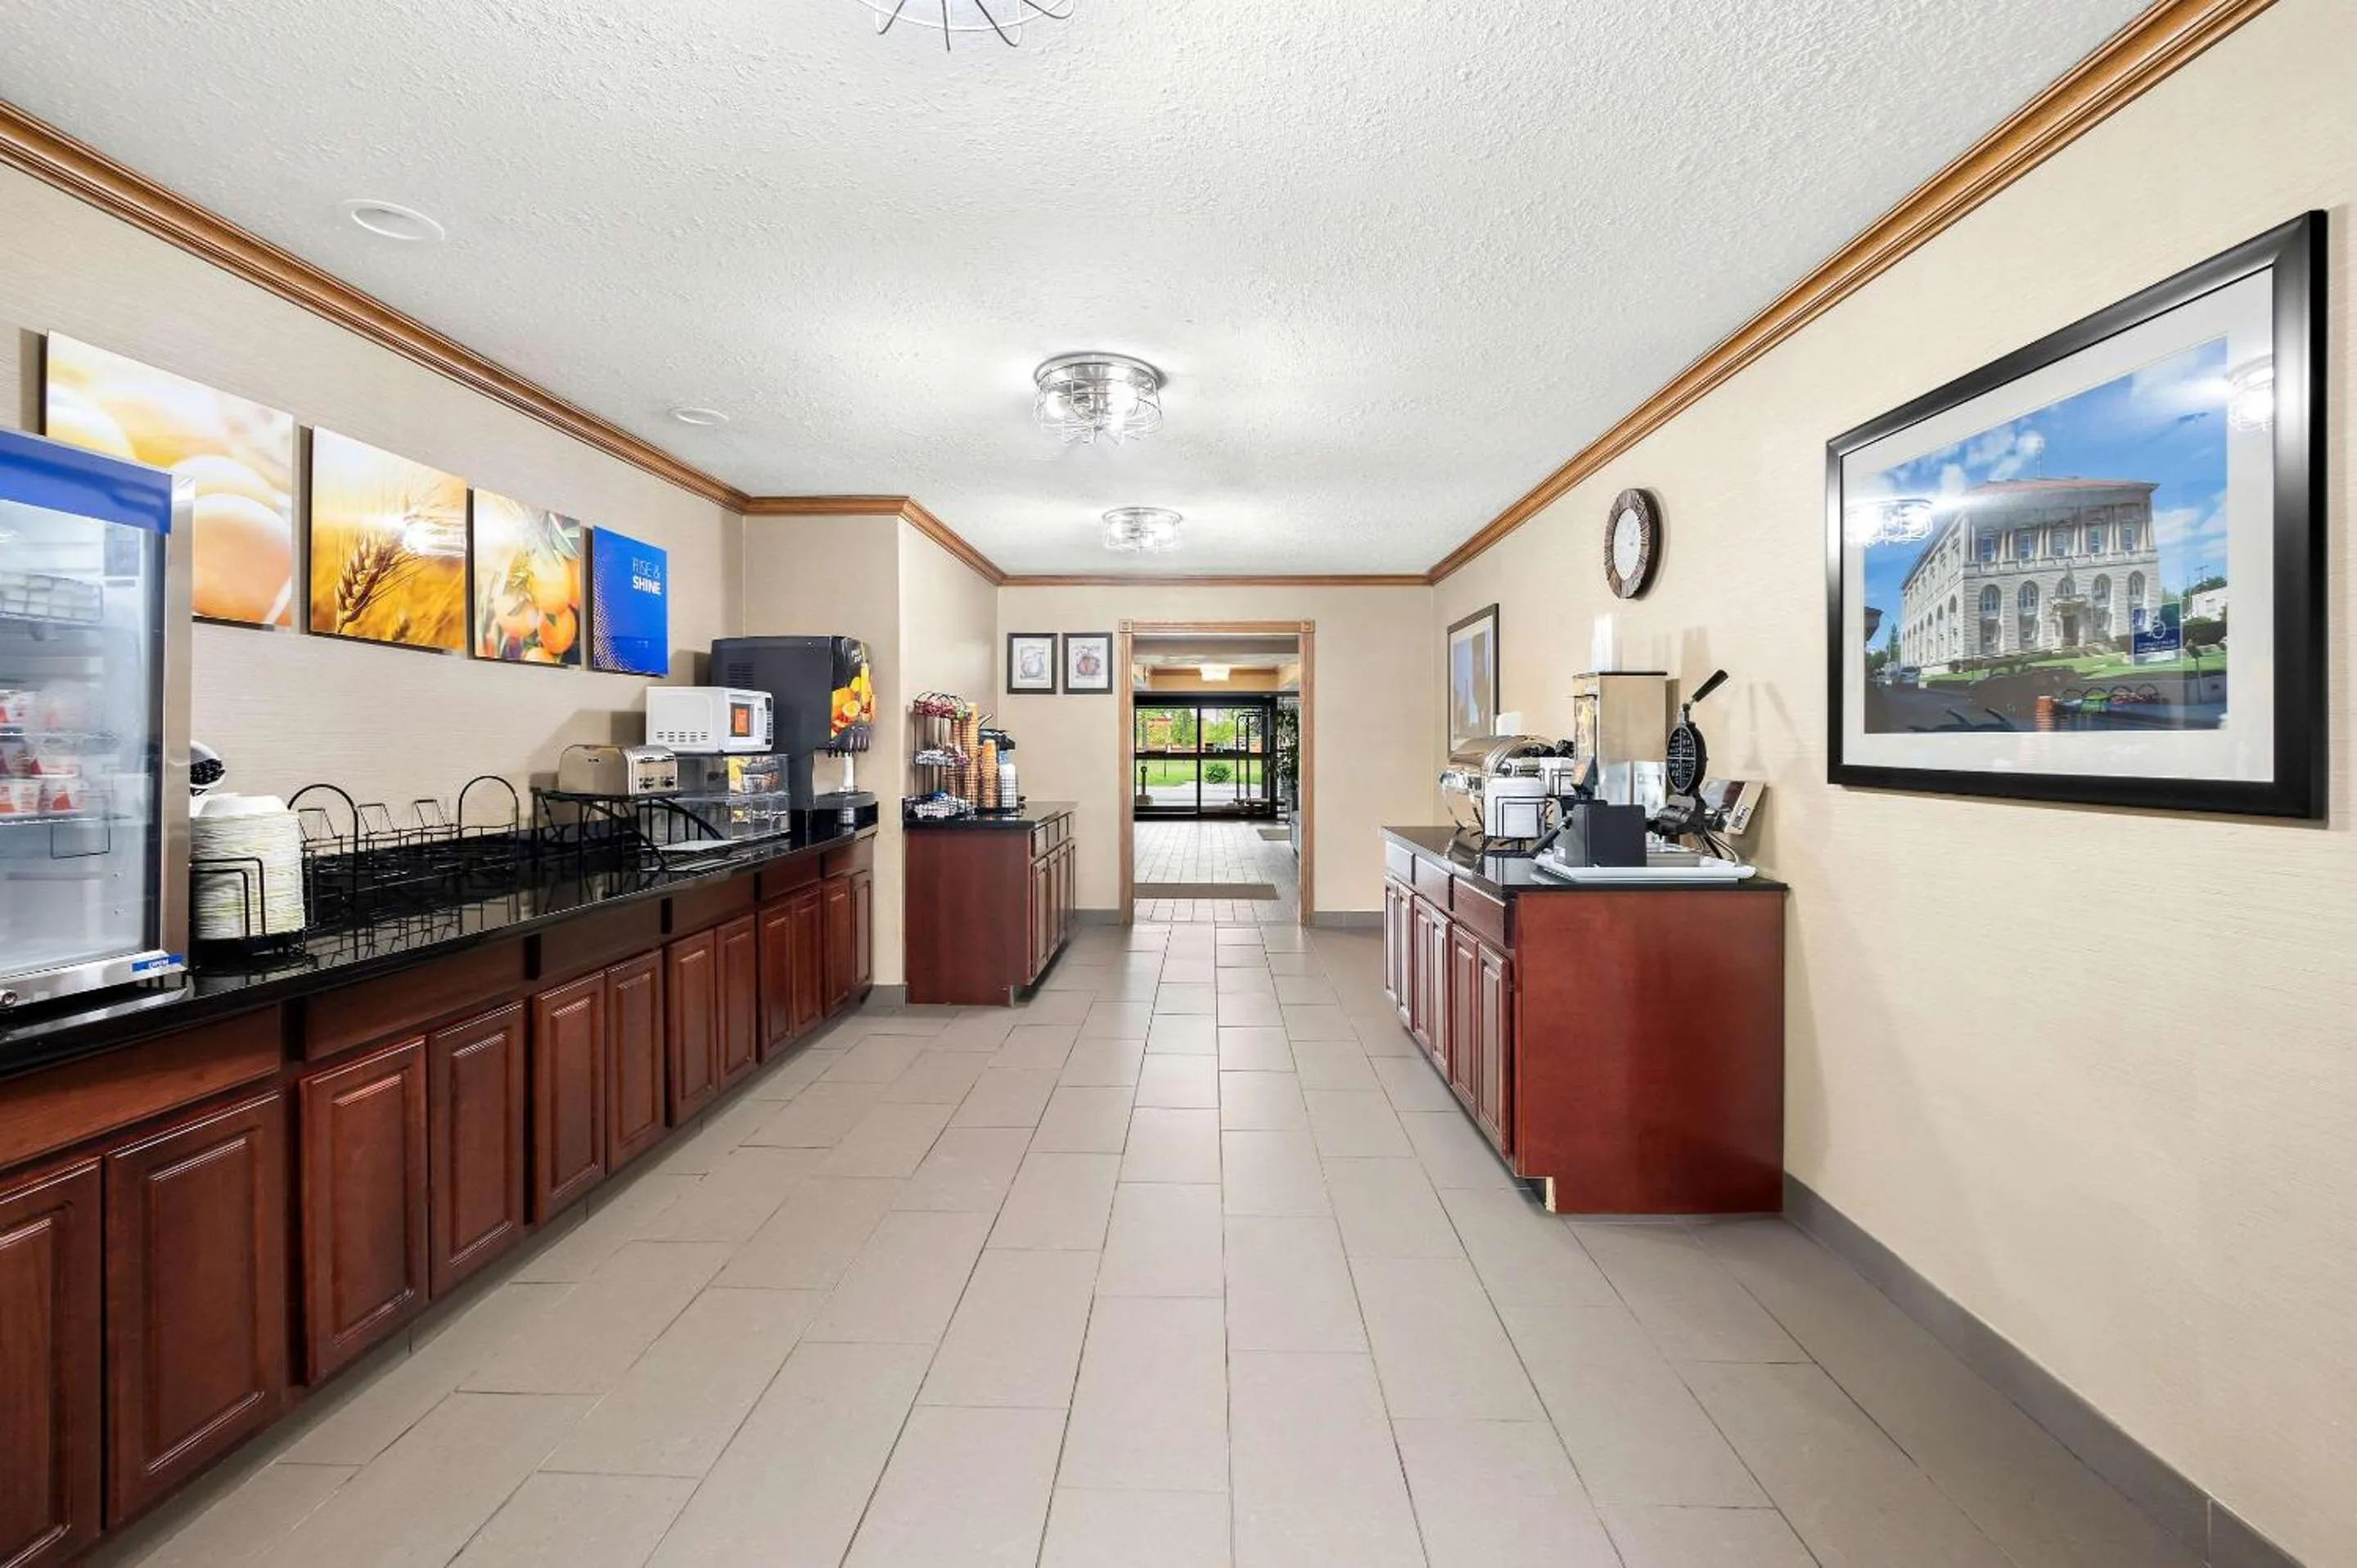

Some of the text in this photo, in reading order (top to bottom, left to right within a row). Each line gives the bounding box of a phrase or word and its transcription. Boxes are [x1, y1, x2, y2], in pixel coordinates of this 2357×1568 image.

[632, 556, 660, 580] RISE &
[633, 575, 661, 595] SHINE
